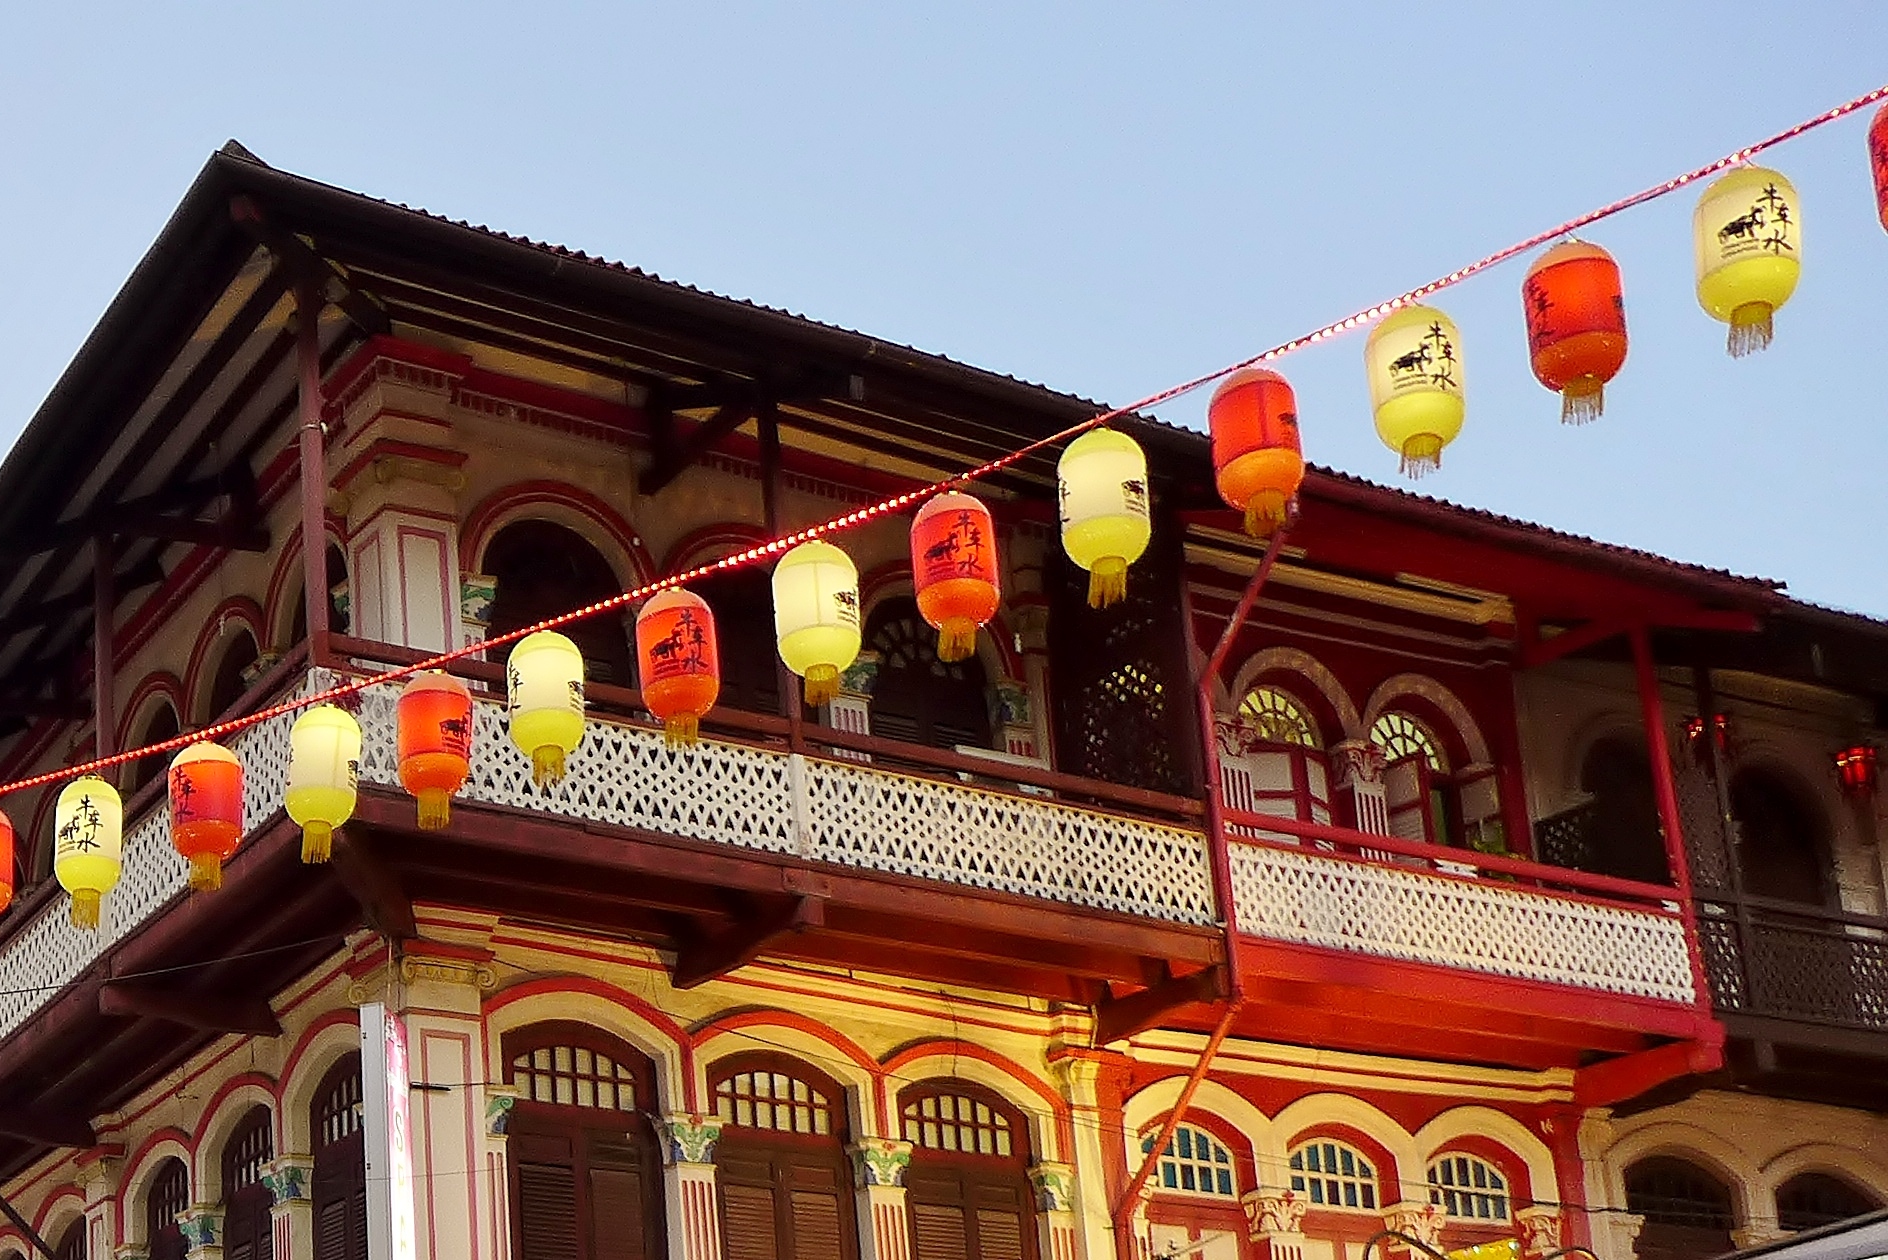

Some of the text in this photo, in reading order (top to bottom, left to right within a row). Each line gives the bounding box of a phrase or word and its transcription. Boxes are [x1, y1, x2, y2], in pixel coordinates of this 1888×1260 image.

[1755, 183, 1794, 255] 牛车水
[1424, 320, 1457, 390] 牛车水
[954, 510, 985, 574] 牛车水
[679, 609, 708, 674] 牛车水
[76, 795, 104, 853] 牛车水
